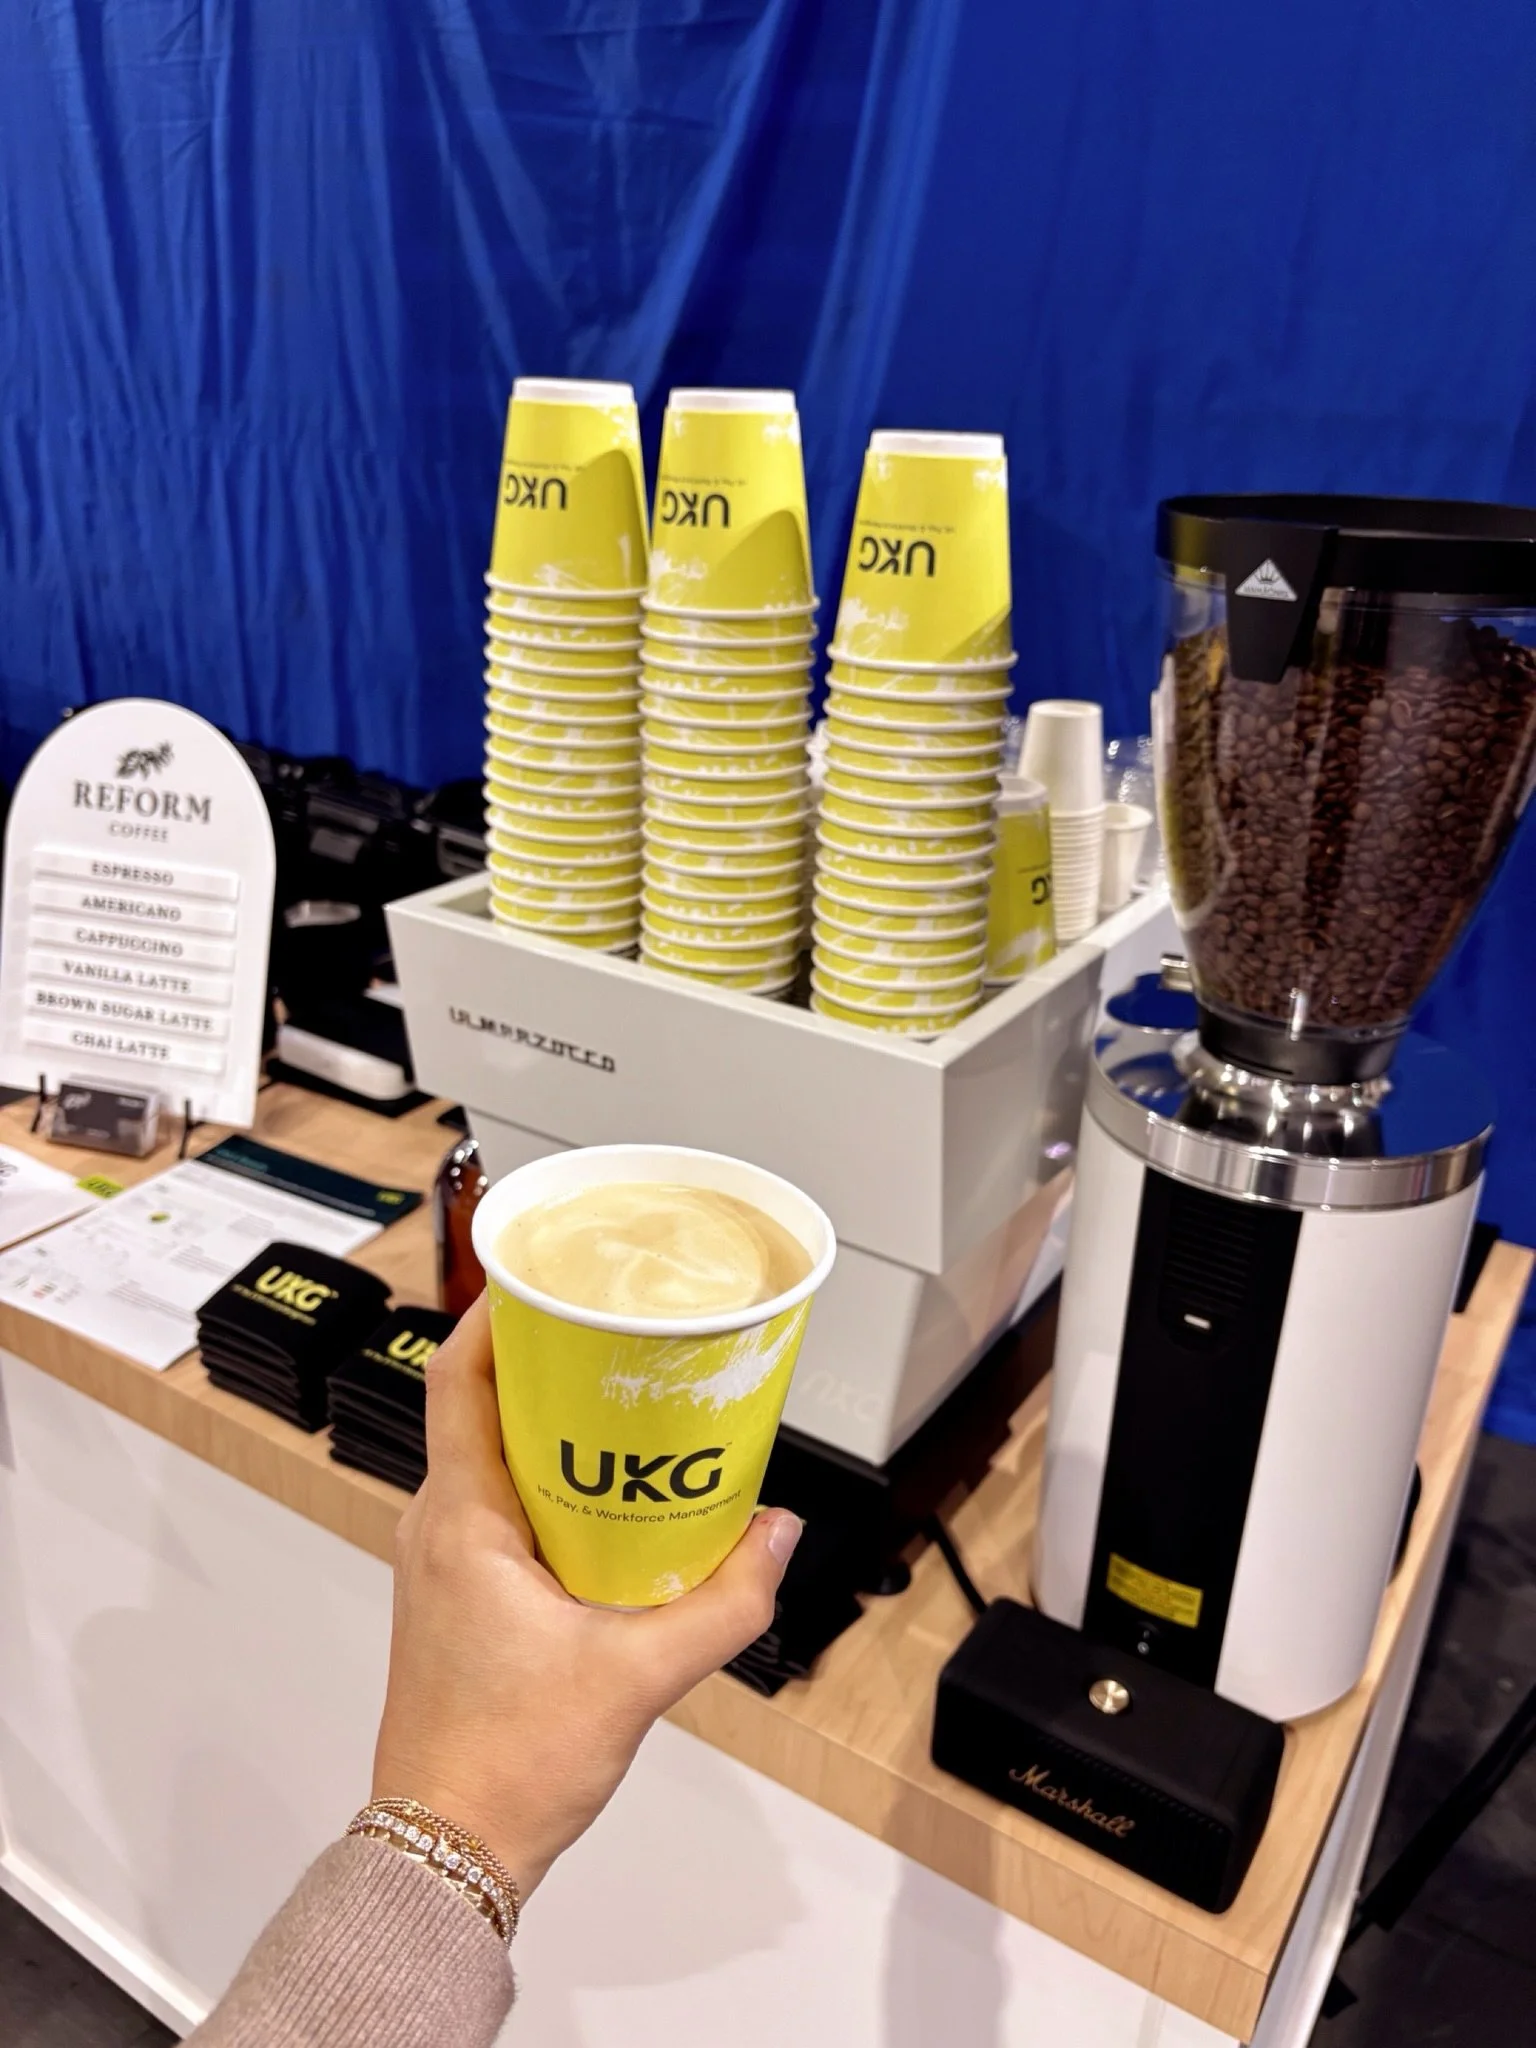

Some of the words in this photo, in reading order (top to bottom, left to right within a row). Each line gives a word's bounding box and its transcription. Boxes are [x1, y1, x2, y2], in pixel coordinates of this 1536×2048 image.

[503, 472, 568, 511] UKG
[661, 489, 731, 528] UKG
[857, 536, 936, 577] UKG
[73, 779, 213, 825] REFORM
[109, 820, 169, 843] COFFEE
[92, 861, 174, 886] ESPRESSO
[82, 895, 182, 922] AMERICANO
[76, 927, 183, 957] CAPPUCCINO
[62, 960, 133, 983] VANILLA
[138, 973, 191, 994] LATTE
[36, 990, 96, 1012] BROWN
[101, 1001, 154, 1022] SUGAR
[159, 1010, 214, 1032] LATTE
[71, 1030, 112, 1050] CHAI
[116, 1035, 171, 1060] LATTE
[255, 1265, 332, 1312] UKG
[387, 1330, 438, 1371] UK
[560, 1439, 726, 1503] UKG
[581, 1505, 592, 1516] &
[596, 1508, 665, 1523] Workforce
[669, 1489, 742, 1521] Management
[1009, 1764, 1136, 1838] Marshall
